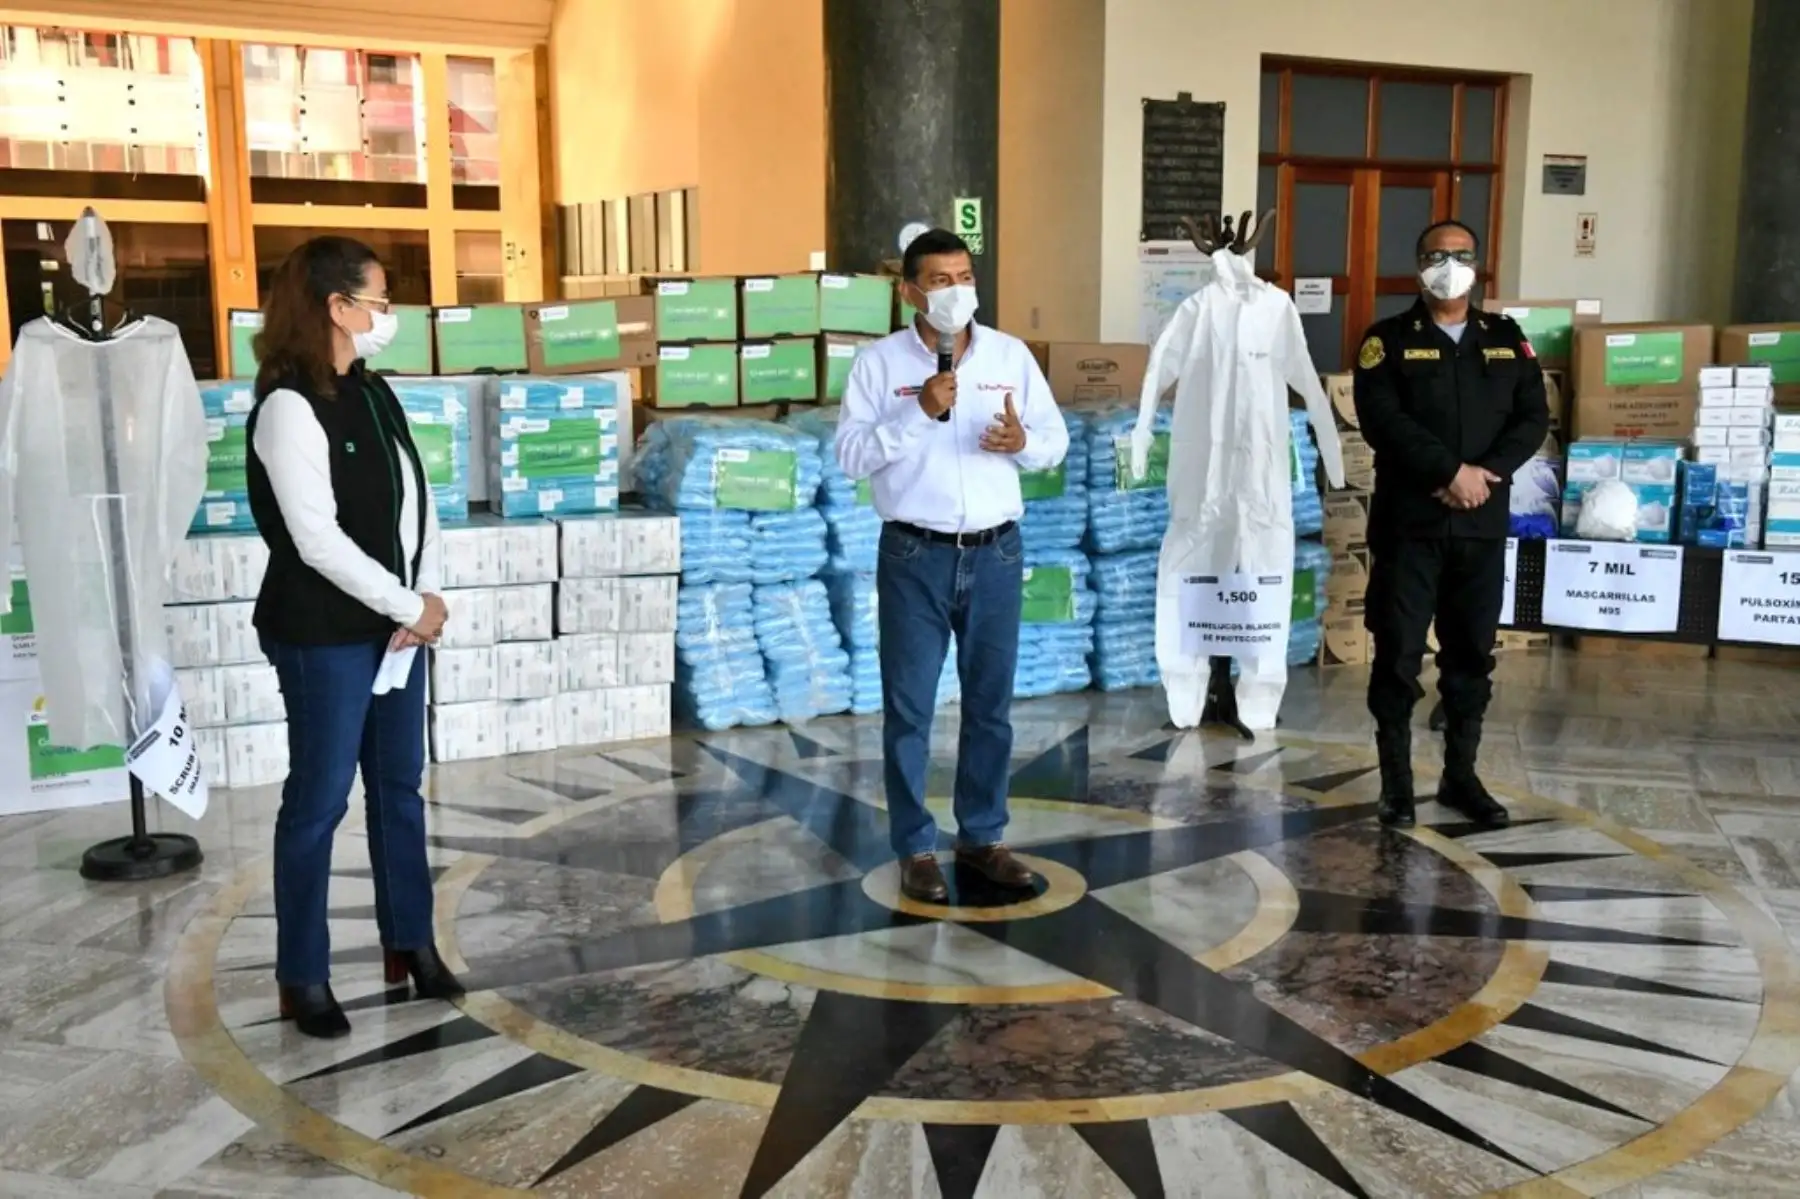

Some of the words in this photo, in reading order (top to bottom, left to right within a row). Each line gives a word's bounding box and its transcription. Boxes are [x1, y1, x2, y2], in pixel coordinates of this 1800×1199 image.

[961, 203, 976, 229] S
[1588, 561, 1599, 574] 7
[1604, 562, 1636, 576] MIL
[1216, 590, 1258, 605] 1,500
[1565, 589, 1657, 603] MASCARRILLAS
[168, 725, 185, 748] 10
